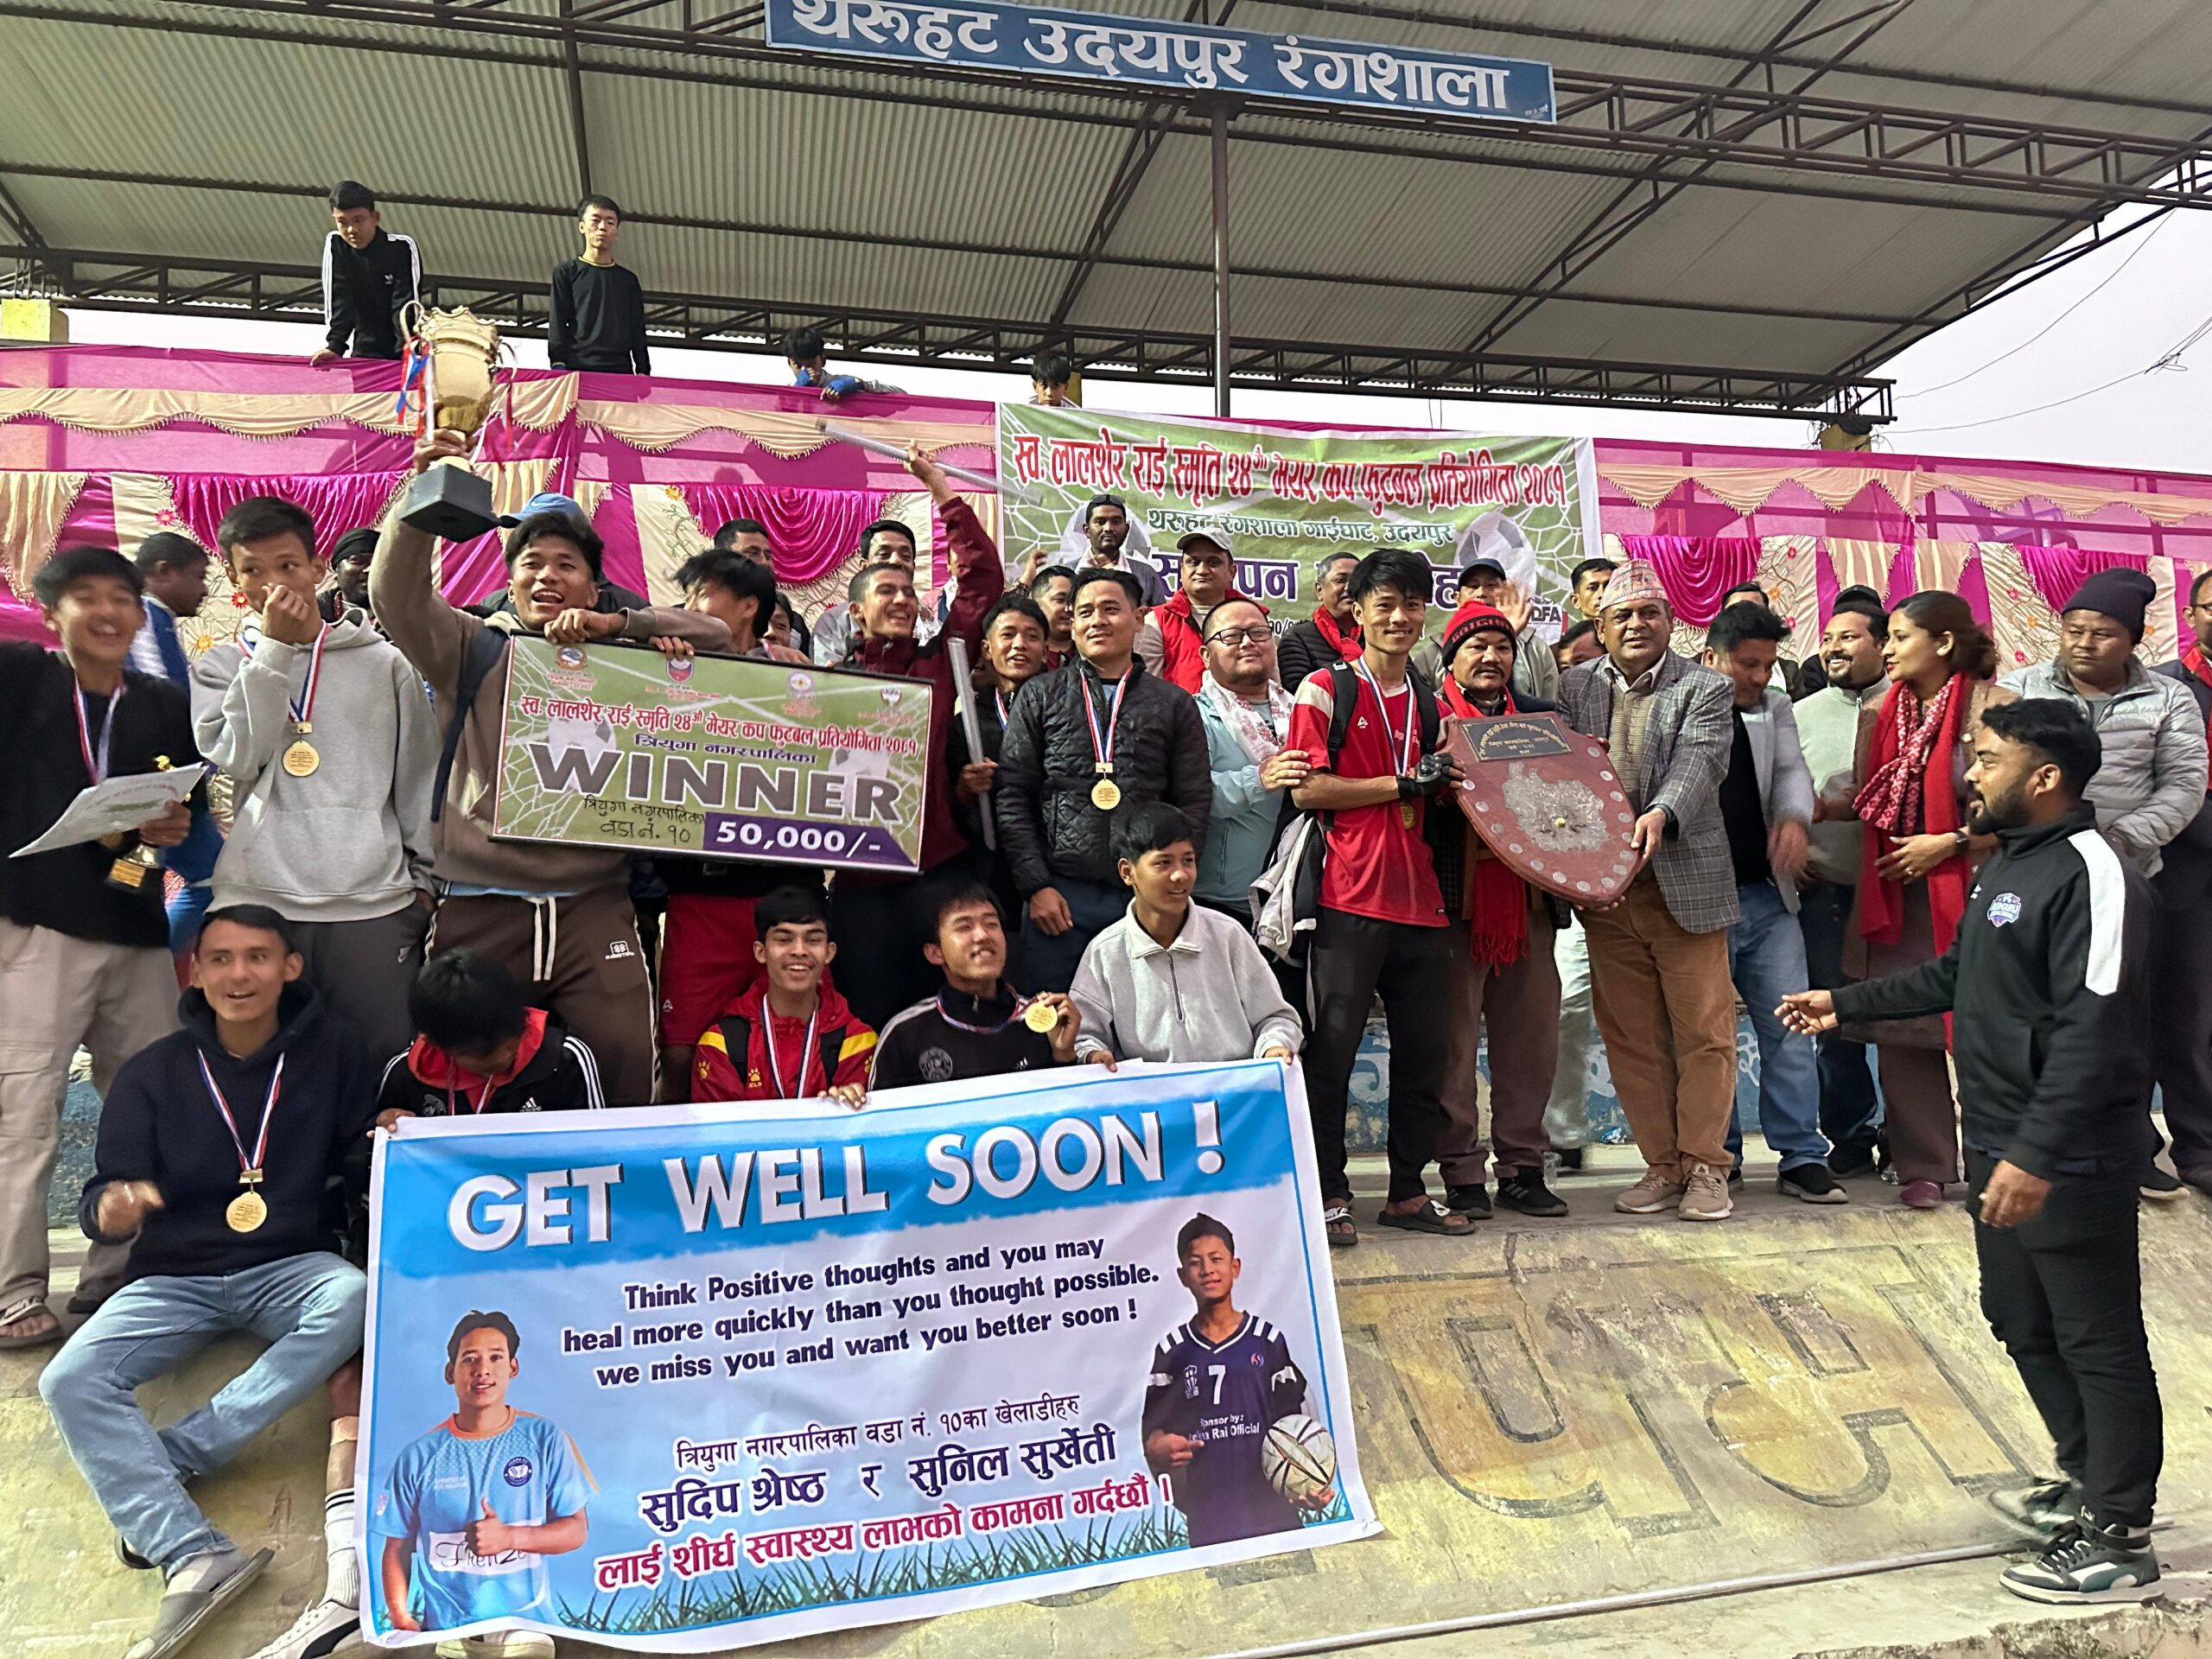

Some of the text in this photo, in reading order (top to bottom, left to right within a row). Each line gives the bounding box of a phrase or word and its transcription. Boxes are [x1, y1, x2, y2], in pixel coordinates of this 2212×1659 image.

[1024, 18, 1249, 89] उदयपुर
[1273, 35, 1510, 110] रंगशाला
[1014, 436, 1045, 484] स्व.
[1050, 428, 1127, 489] लालशेर
[1134, 437, 1167, 497] राई
[1173, 443, 1223, 506] स्मृति
[1273, 453, 1318, 502] मेयर
[1322, 463, 1356, 500] कप
[1360, 463, 1422, 516] फुटबल
[1427, 450, 1518, 511] प्रतियोगिता
[1522, 464, 1566, 505] २०८१
[1219, 513, 1298, 536] रंगशाला
[1385, 523, 1455, 546] उदयपुर
[547, 698, 604, 723] लालशेर
[607, 704, 631, 730] राई
[636, 706, 671, 733] स्मृति
[706, 713, 739, 739] मेयर
[741, 721, 766, 741] कप
[769, 725, 814, 748] फुटबल
[818, 725, 882, 753] प्रतियोगिता
[527, 741, 903, 824] WINNER
[668, 824, 691, 846] १०
[716, 820, 881, 859] 50,000/-
[448, 1100, 1225, 1253] GET WELL SOON !
[563, 1262, 1160, 1352] heal more quickly than you thought possible.
[625, 1237, 1104, 1310] Think Positive thoughts and you may
[597, 1364, 639, 1387] we
[652, 1354, 712, 1381] miss
[724, 1351, 775, 1377] you
[785, 1337, 834, 1364] and
[844, 1329, 909, 1357] want
[920, 1322, 968, 1351] you
[976, 1312, 1052, 1340] better
[1062, 1305, 1120, 1329] soon
[1208, 1364, 1226, 1405] 7
[677, 1440, 737, 1472] त्रियुगा
[746, 1423, 857, 1457] नगरपालिका
[865, 1420, 904, 1444] वडा
[1211, 1426, 1228, 1440] Rai
[1230, 1422, 1260, 1437] Official
[642, 1422, 1116, 1533] सुदिप श्रेष्ठ र सुनिल सुर्खेती
[598, 1542, 664, 1590] लाई
[863, 1503, 963, 1549] लाभको
[970, 1493, 1064, 1531] कामना
